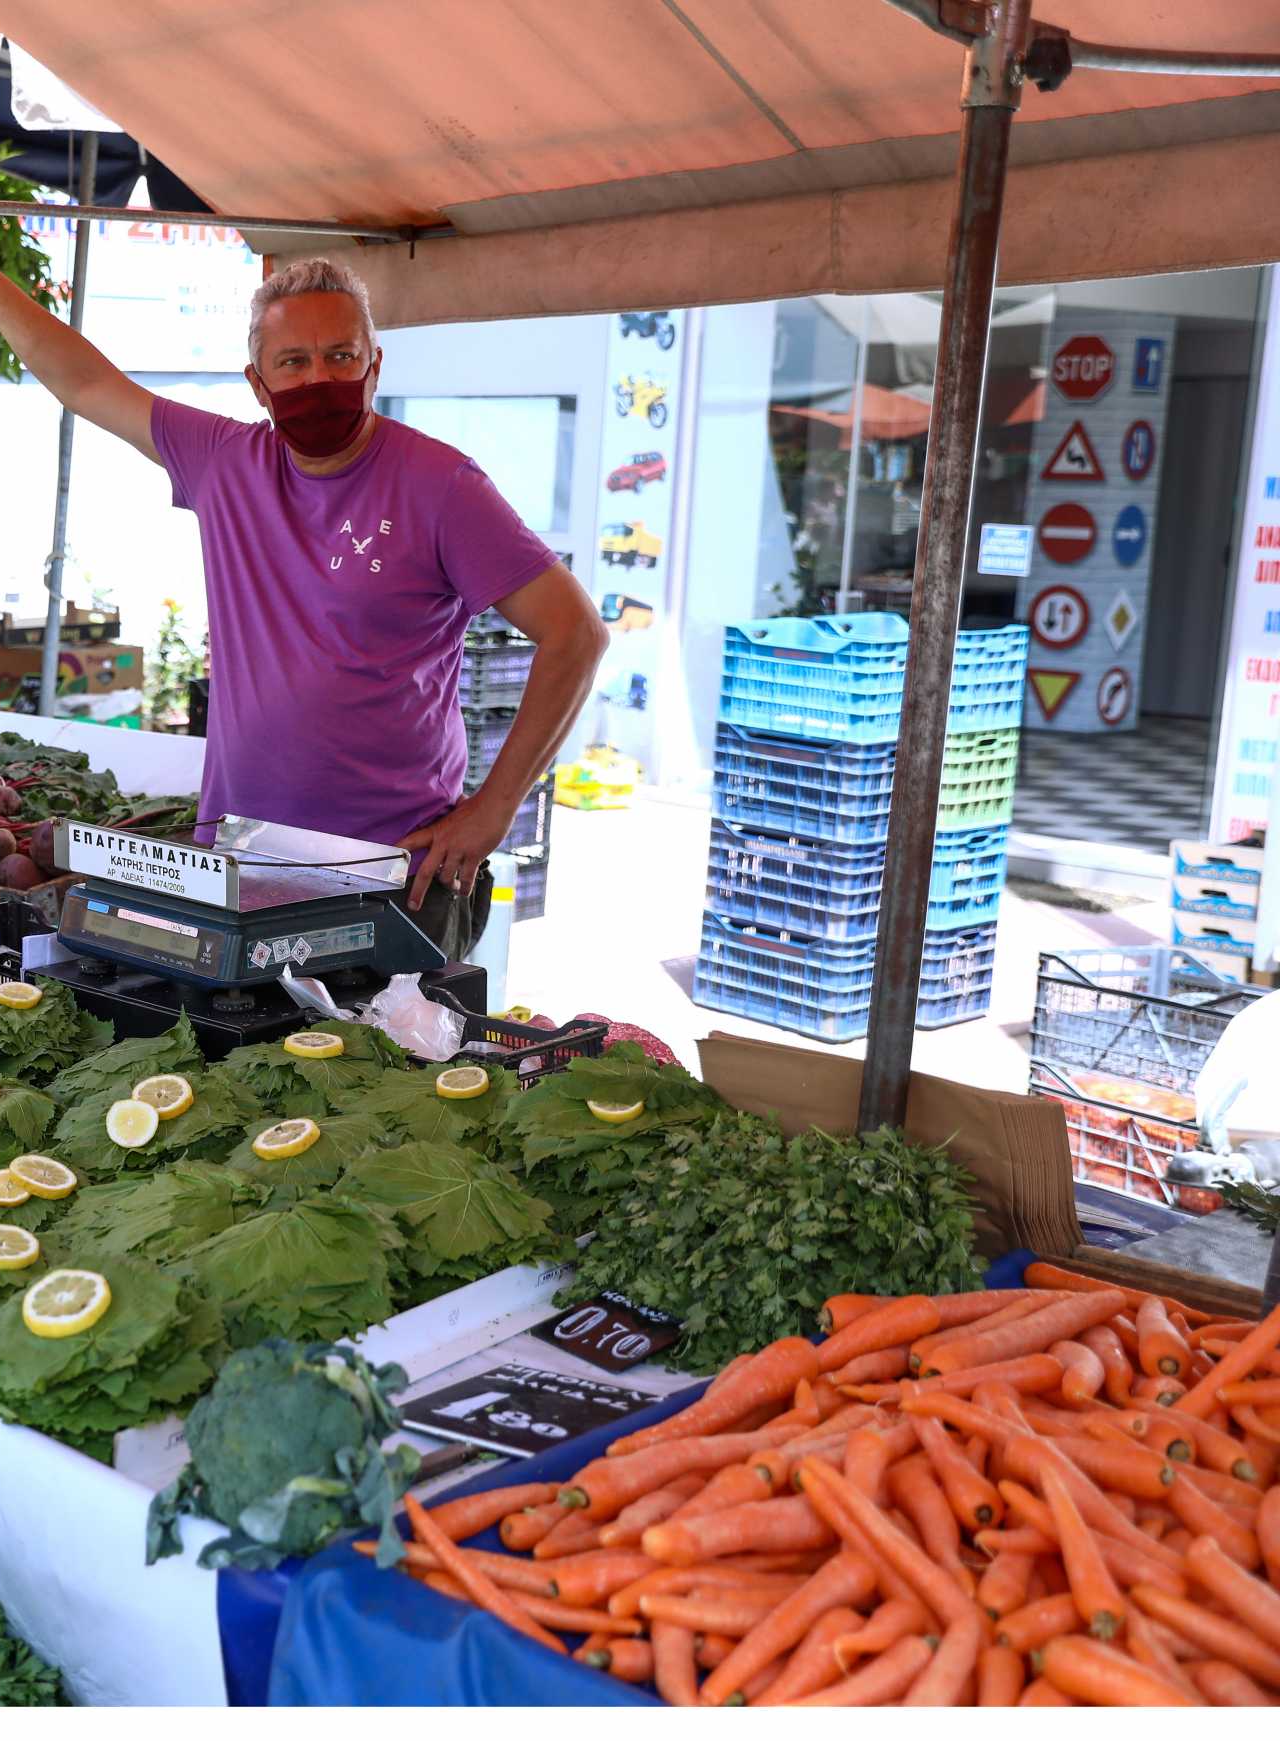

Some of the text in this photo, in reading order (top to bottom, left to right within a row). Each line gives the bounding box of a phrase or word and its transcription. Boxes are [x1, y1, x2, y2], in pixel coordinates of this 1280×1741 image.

[1055, 355, 1110, 381] STOP
[339, 519, 392, 535] A E
[330, 556, 382, 573] U S
[72, 828, 222, 874] ΕΠΑΓΓΕΛΜΑΤΙΑΣ
[110, 855, 181, 880] ΚΑΤΡΗΣ ΠΕΤΡΟΣ
[120, 871, 145, 884] ΑΔΕΙΑΣ
[148, 877, 185, 894] 11474/2009
